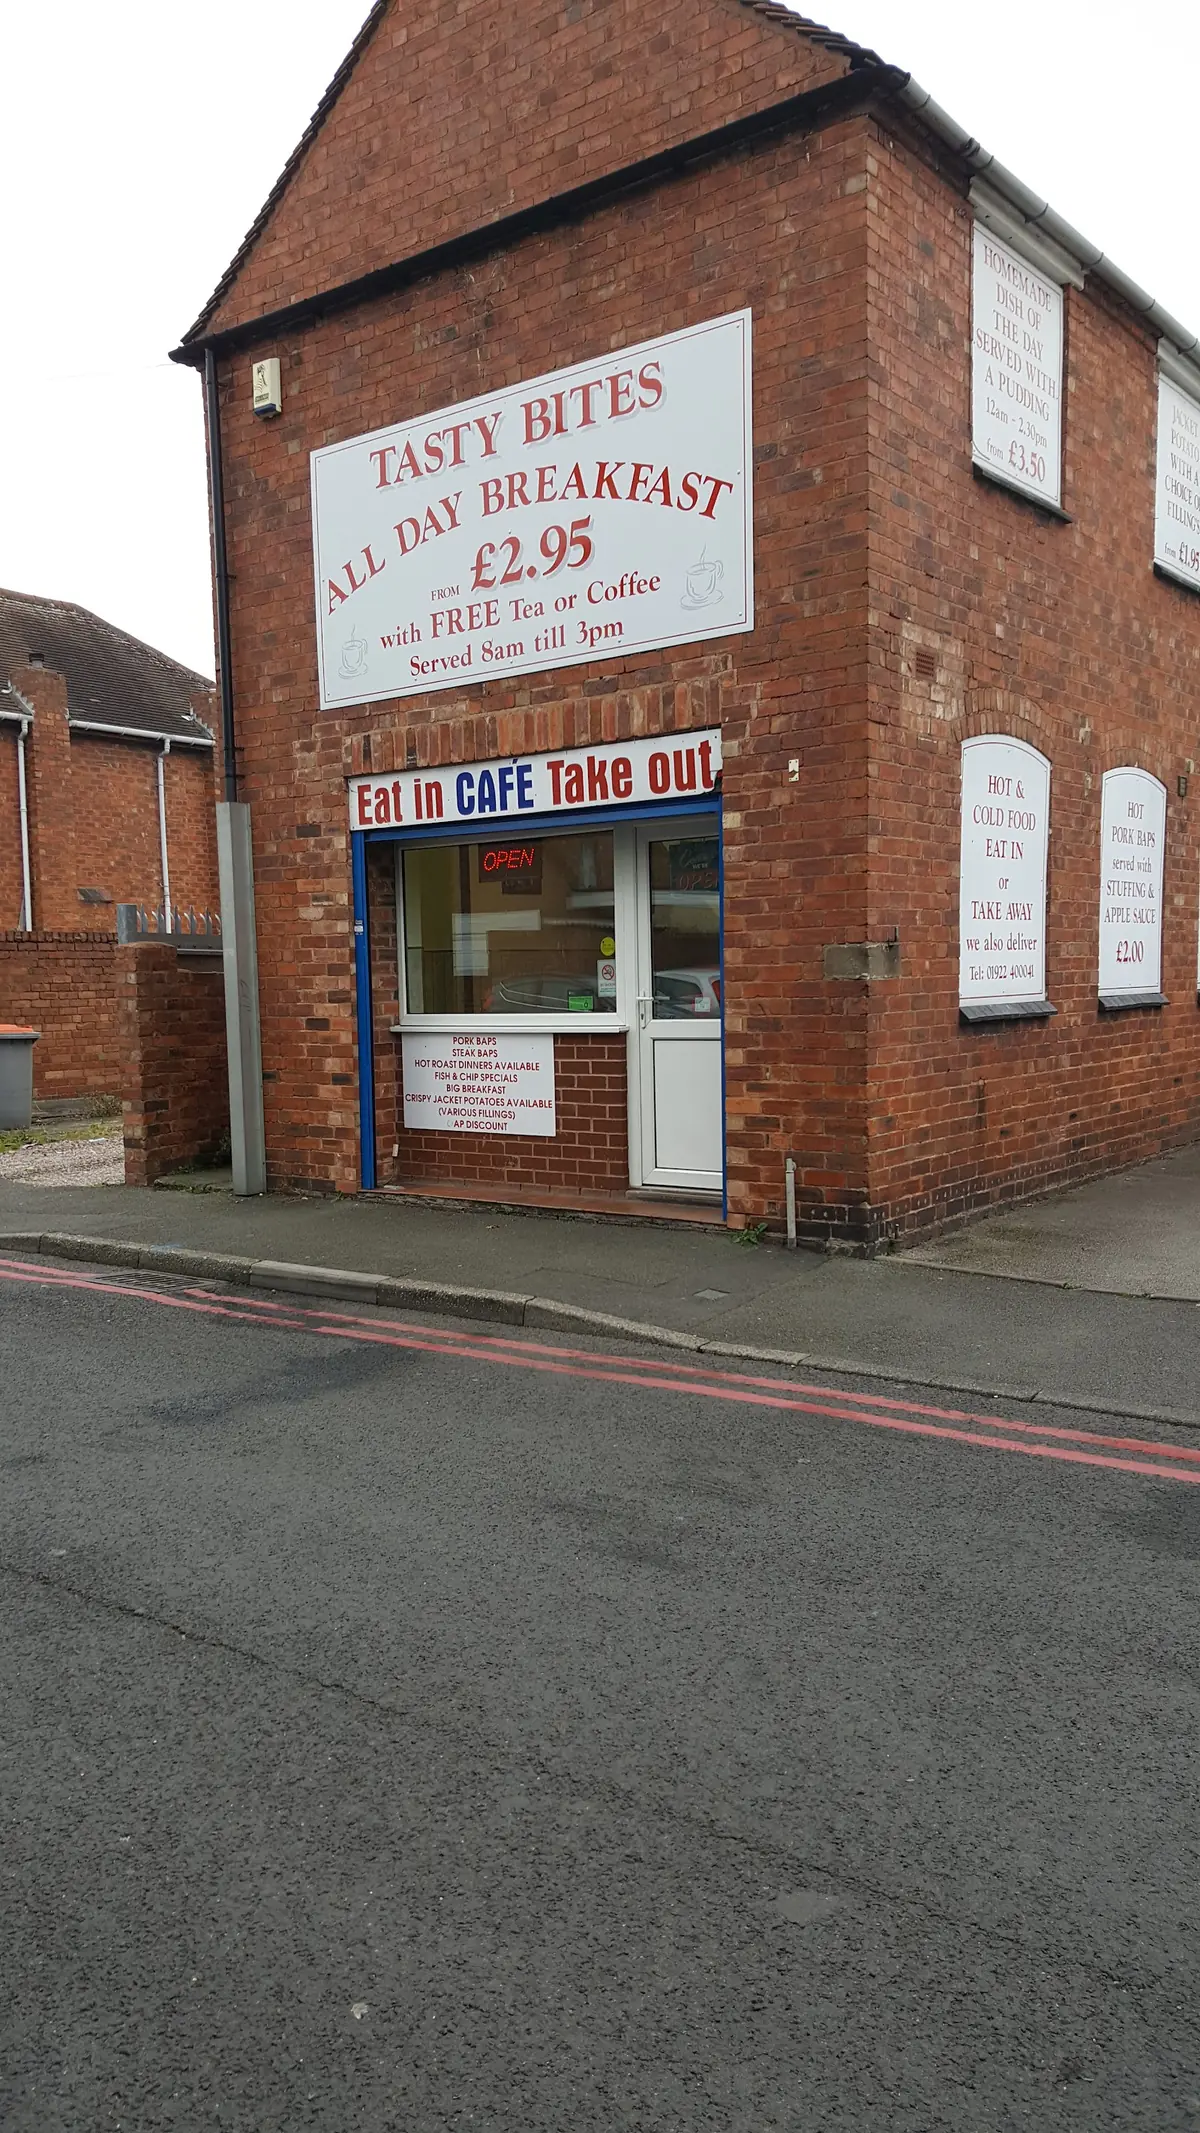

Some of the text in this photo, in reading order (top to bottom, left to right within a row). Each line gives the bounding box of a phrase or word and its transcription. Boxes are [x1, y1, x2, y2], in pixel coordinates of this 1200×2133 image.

[984, 244, 1051, 312] HOMEMADE
[996, 282, 1041, 331] DISH OF
[993, 309, 1043, 362] THE DAY
[976, 327, 1056, 399] SERVED WITH
[985, 365, 1049, 421] A PUDDING
[369, 361, 664, 489] TASTY BITES
[986, 397, 1008, 424] 12am
[1018, 417, 1047, 448] 2.30pm
[1172, 405, 1198, 437] JACKET
[986, 438, 1046, 482] from £3.50
[1171, 452, 1199, 486] WITH A
[1165, 474, 1192, 505] CHOICE
[324, 461, 734, 614] ALL DAY BREAKFAST
[430, 515, 593, 602] FROM £2.95
[1165, 542, 1176, 559] from
[380, 571, 661, 649] with FREE Tea or Coffee
[409, 619, 624, 676] Served 8am till 3pm
[357, 781, 403, 825] Eat
[414, 778, 443, 819] in
[547, 756, 633, 805] Take
[649, 740, 714, 794] out
[988, 774, 1025, 799] HOT &
[973, 804, 1036, 831] COLD FOOD
[1127, 801, 1144, 820] HOT
[1112, 825, 1156, 848] PORK BAPS
[484, 847, 536, 872] OPEN
[986, 838, 1024, 860] EAT IN
[1112, 855, 1152, 873] served with
[998, 877, 1009, 890] or
[1106, 879, 1155, 899] STUFFING &
[971, 900, 1033, 921] TAKE AWAY
[1104, 907, 1156, 924] APPLE SAUCE
[966, 932, 1037, 951] we also deliver
[1116, 940, 1144, 963] £2.00
[969, 966, 984, 981] Tel:
[986, 965, 1007, 979] 01922
[452, 1036, 497, 1046] PORK BAPS
[452, 1048, 498, 1058] STEAK BAPS
[414, 1059, 540, 1071] HOT ROAST DINNERS AVAILABLE
[434, 1072, 518, 1083] FISH & CHIP SPECIALS
[446, 1084, 506, 1094] BIG BREAKFAST
[405, 1094, 553, 1109] CRISPY JACKET POTATOES AVAILABLE
[438, 1107, 516, 1120] (VARIOUS FILLINGS)
[466, 1121, 508, 1131] DISCOUNT
